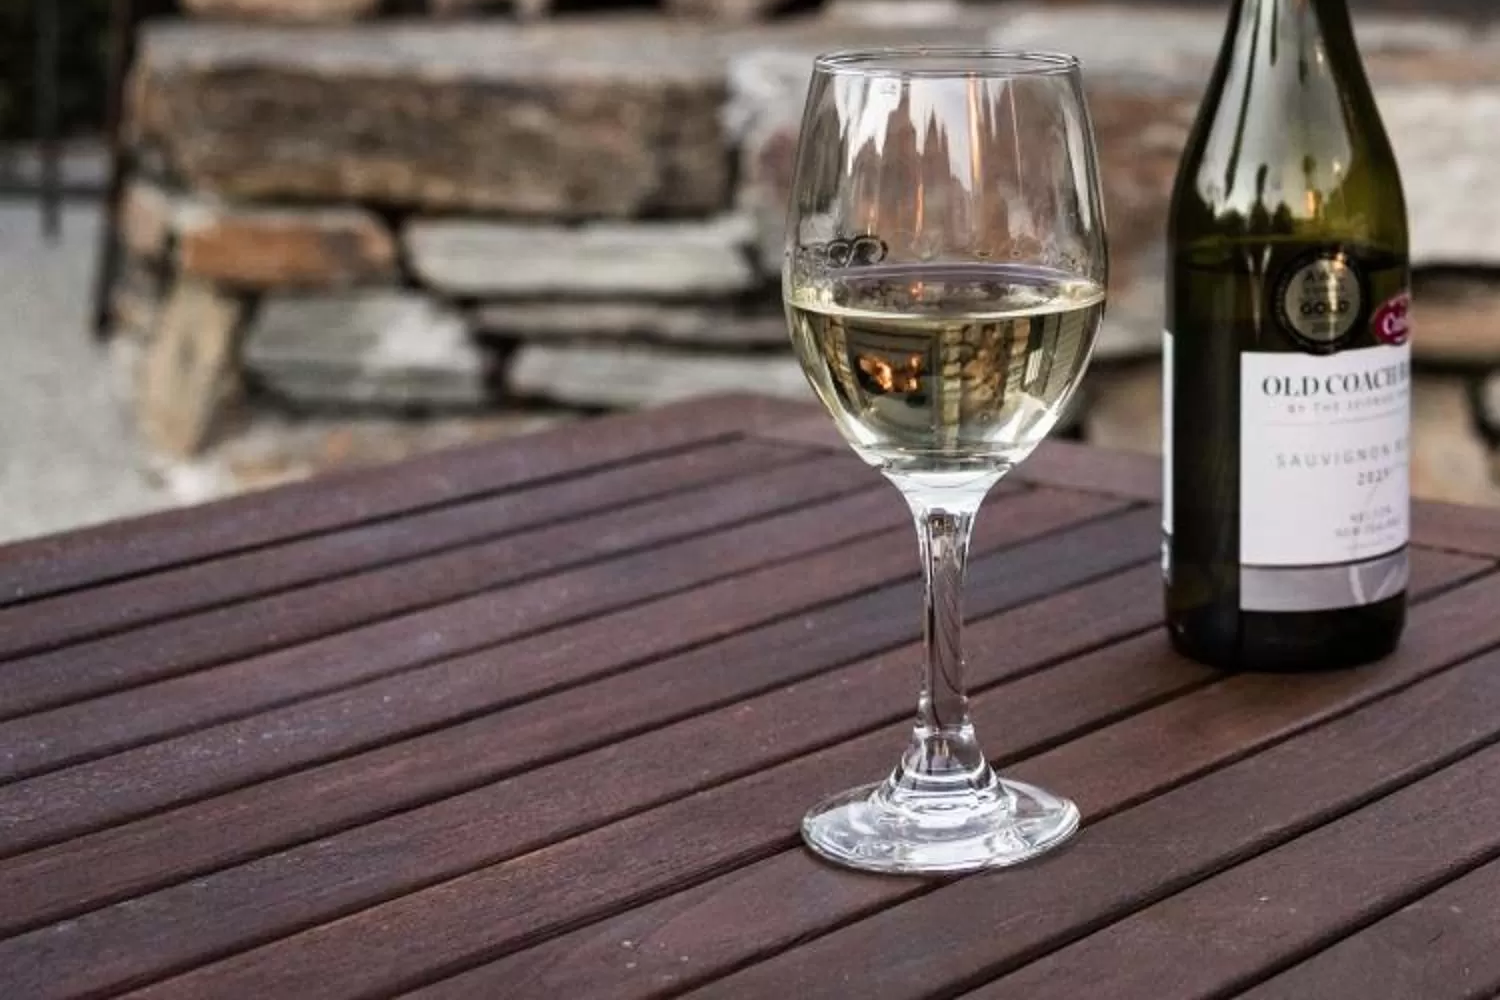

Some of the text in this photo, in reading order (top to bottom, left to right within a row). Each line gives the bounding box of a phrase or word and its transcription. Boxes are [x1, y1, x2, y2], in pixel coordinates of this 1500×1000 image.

[1262, 375, 1320, 396] OLD
[1325, 365, 1397, 395] COACH
[1275, 443, 1390, 469] SAUVIGNON
